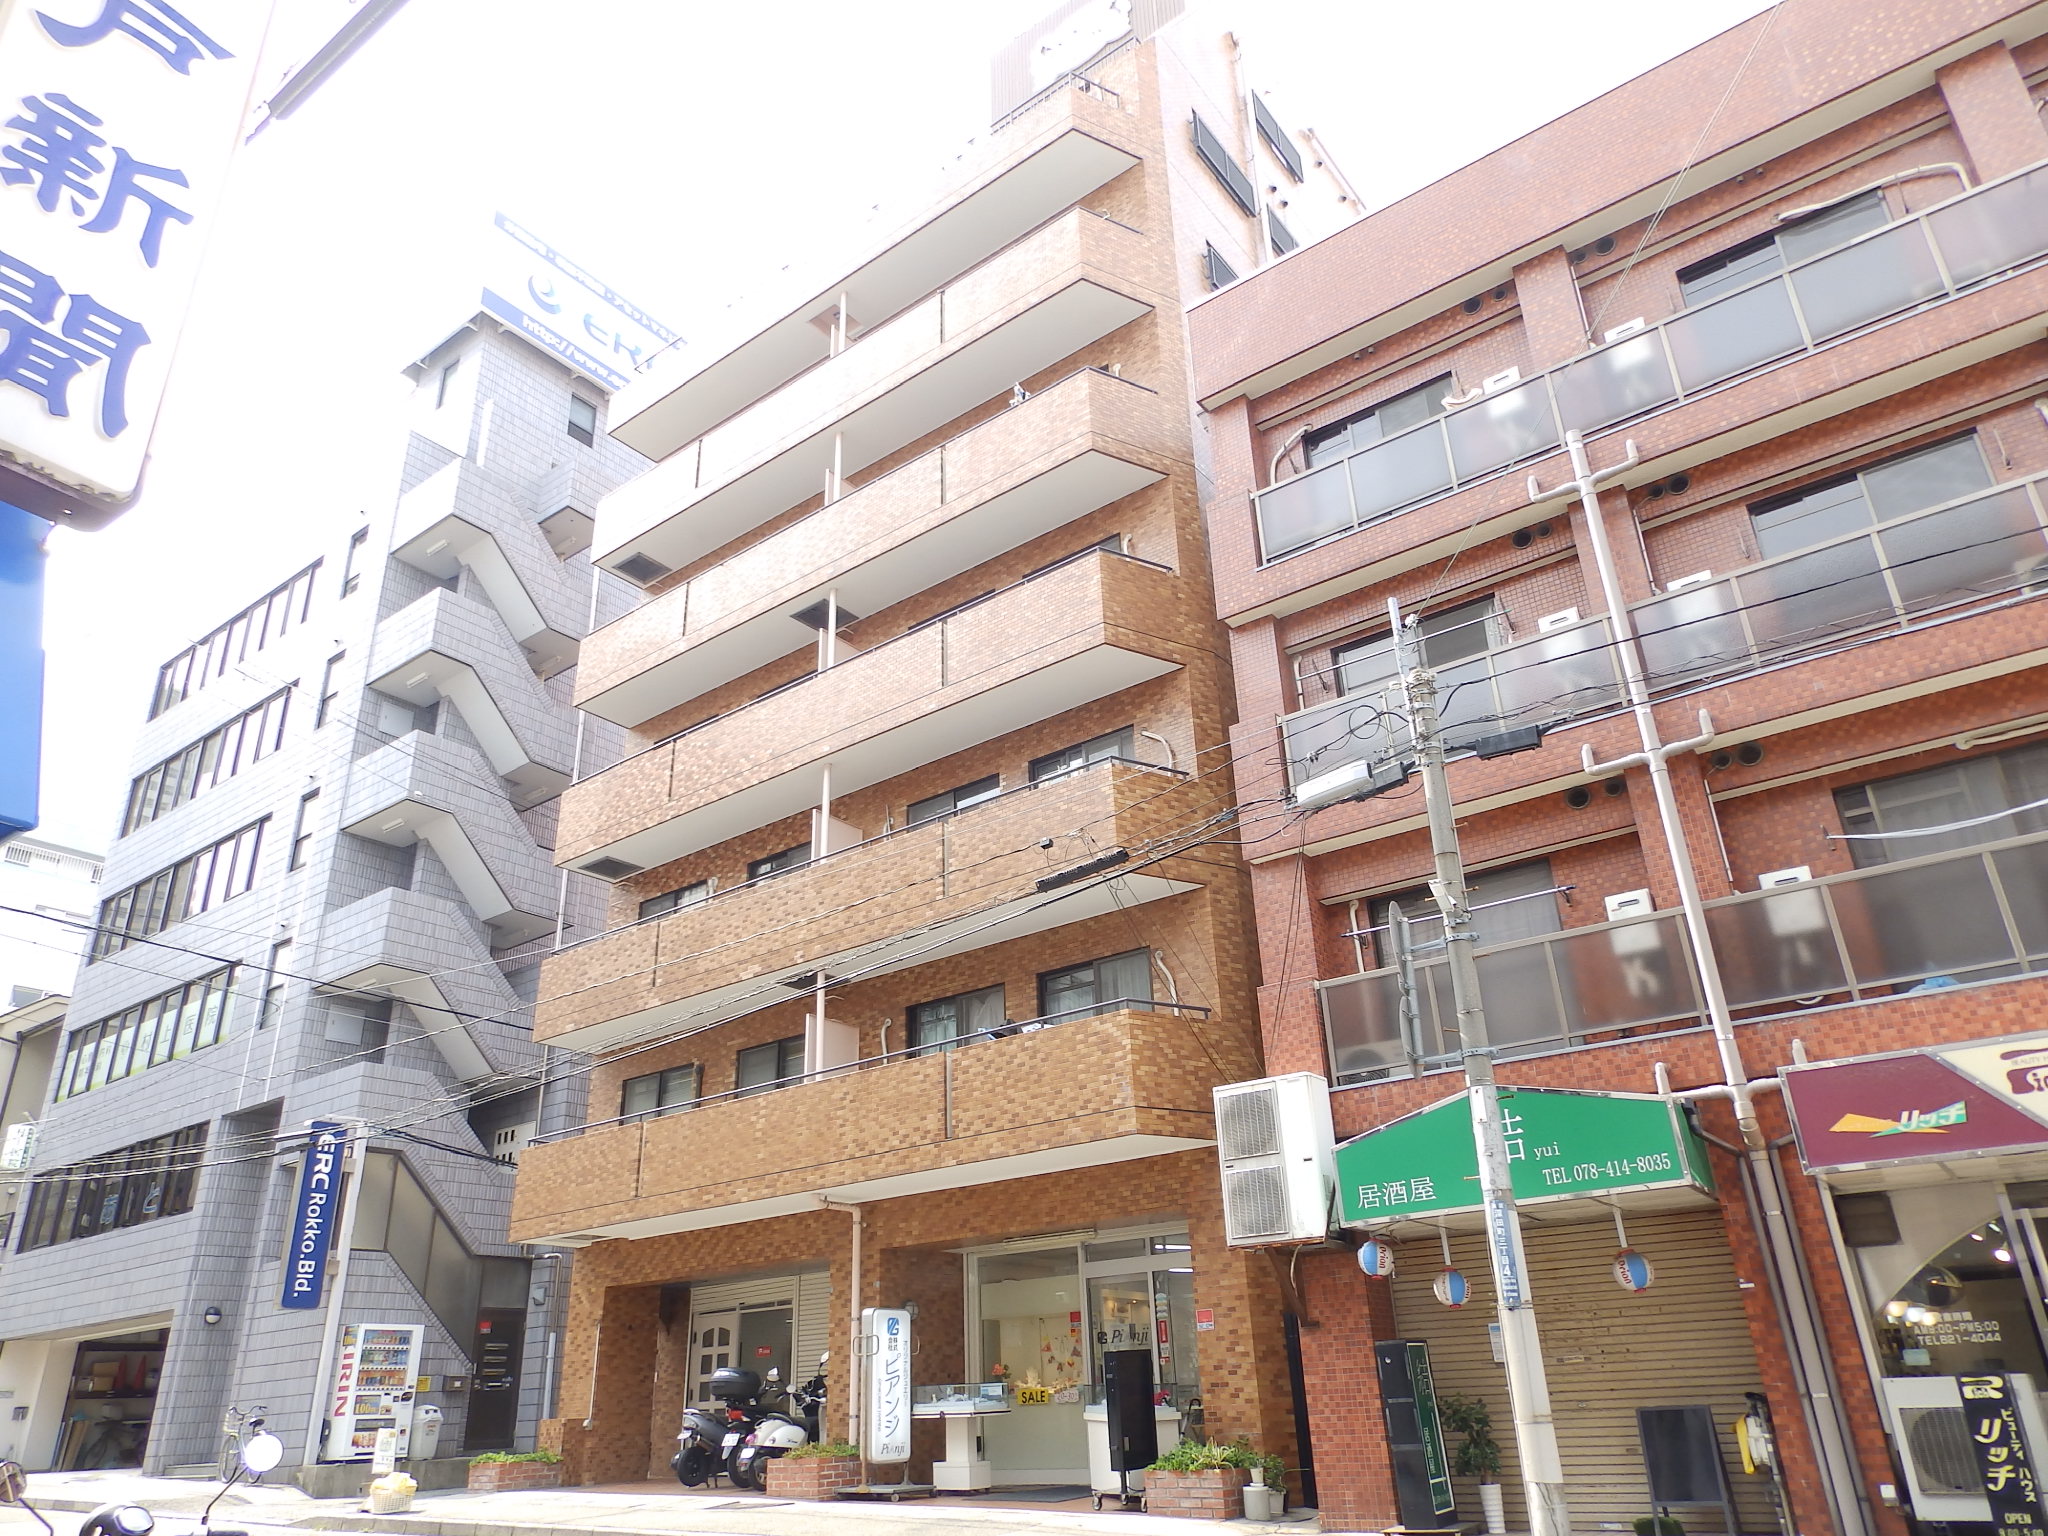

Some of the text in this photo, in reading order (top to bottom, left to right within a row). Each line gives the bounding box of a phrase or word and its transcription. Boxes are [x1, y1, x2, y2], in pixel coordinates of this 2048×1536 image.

[1897, 1100, 1966, 1131] リッチ
[1533, 1141, 1561, 1160] yui
[1542, 1152, 1672, 1186] TEL 078-414-8035
[1357, 1176, 1437, 1209] 居酒屋
[334, 1346, 355, 1417] IRIN
[885, 1353, 901, 1438] ピアンジ
[1021, 1390, 1046, 1404] SALE
[1974, 1418, 2016, 1491] リッチ
[2019, 1468, 2037, 1502] ハウス
[2005, 1512, 2032, 1525] OPEN
